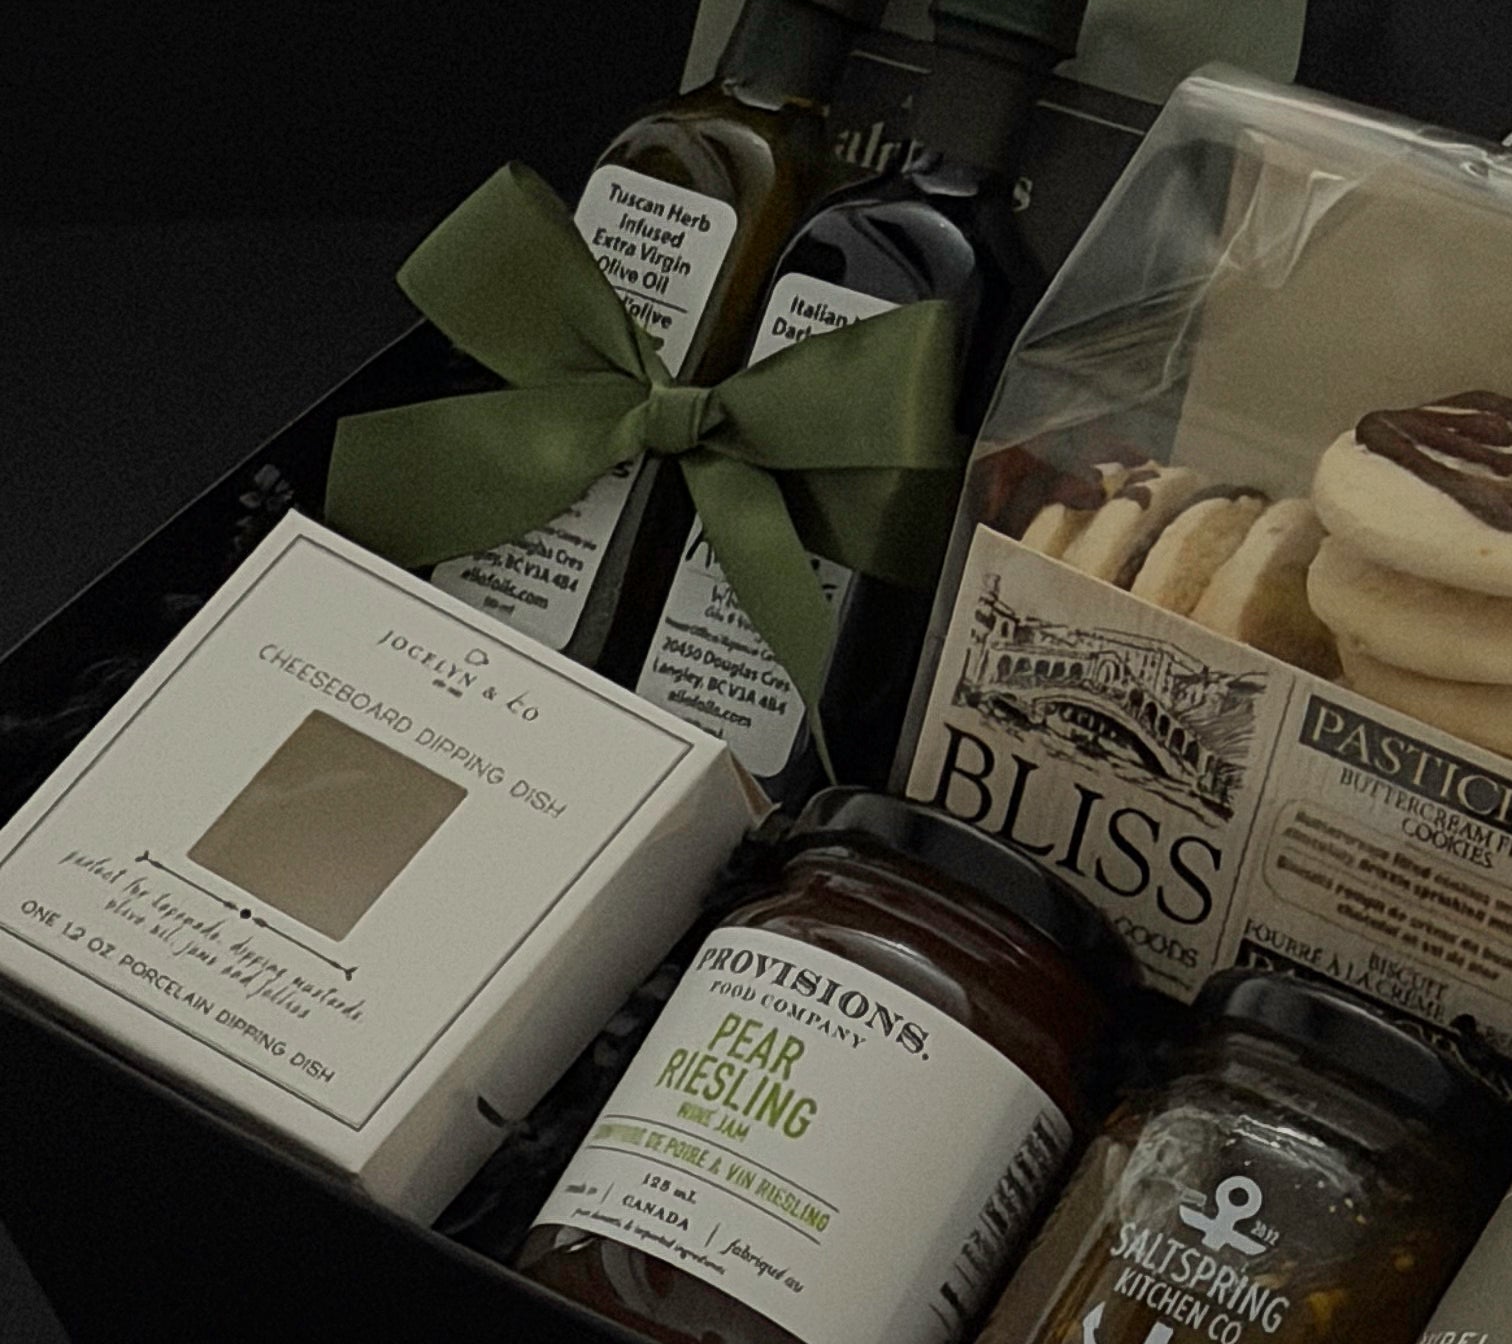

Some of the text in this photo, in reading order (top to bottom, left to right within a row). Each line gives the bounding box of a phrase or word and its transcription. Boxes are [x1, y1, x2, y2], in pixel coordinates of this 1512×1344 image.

[608, 182, 711, 233] Tuscan Herb
[619, 213, 685, 248] Infused
[592, 228, 691, 277] Extra Virgin
[597, 256, 670, 295] Olive Oil
[790, 293, 848, 328] Italian
[378, 630, 478, 688] JOCELYN
[482, 686, 498, 701] &
[703, 651, 758, 680] Douglas
[707, 676, 728, 695] BC
[258, 643, 568, 819] CHEESEBOARD DIPPING DISH
[933, 723, 1223, 925] BLISS
[1340, 767, 1492, 848] BUTTERCREAM
[1402, 818, 1493, 869] COOKIES
[20, 899, 62, 928] ONE
[87, 937, 116, 959] OZ
[119, 954, 214, 1016] PORCELAIN
[215, 1008, 286, 1057] DIPPING
[289, 1051, 336, 1084] DISH
[1369, 952, 1448, 1000] BISCUIT
[709, 979, 866, 1049] FOOD COMPANY
[707, 1012, 805, 1081] PEAR
[655, 1048, 817, 1139] RIESLING
[714, 1115, 750, 1143] JAM
[643, 1173, 671, 1193] 125
[667, 1136, 710, 1168] POIRE
[725, 1162, 757, 1190] VIN
[755, 1178, 831, 1233] RIESLING
[622, 1195, 689, 1231] CANADA
[720, 1239, 785, 1281] fabriqué
[1110, 1221, 1290, 1333] SALTSPRING
[1114, 1267, 1210, 1330] KITCHEN
